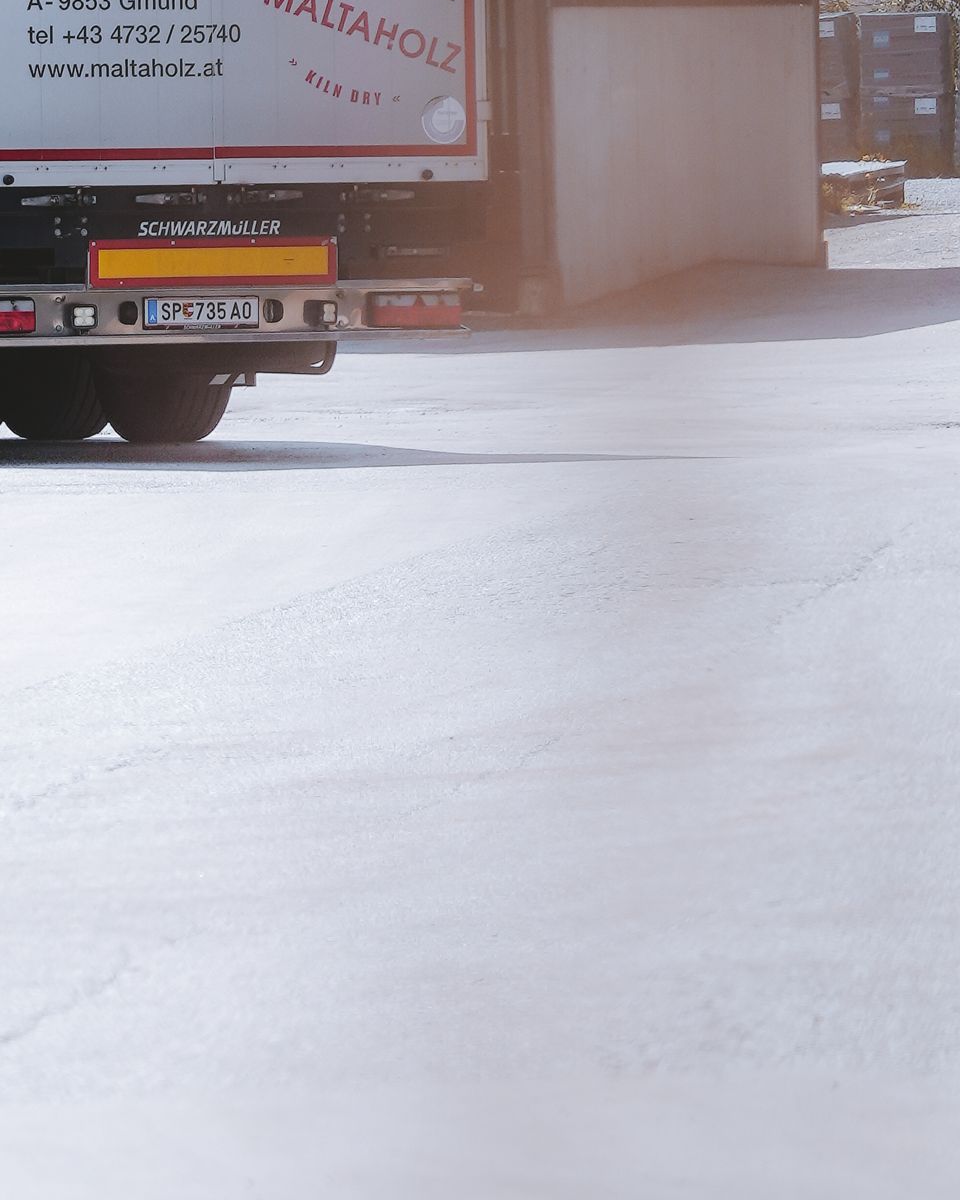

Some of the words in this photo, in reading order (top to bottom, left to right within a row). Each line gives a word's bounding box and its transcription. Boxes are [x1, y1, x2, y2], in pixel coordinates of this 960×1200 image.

[27, 25, 54, 45] tel
[62, 25, 103, 45] +43
[110, 25, 161, 45] 4732
[180, 24, 242, 44] 25740
[28, 58, 224, 78] www.maltaholz.at
[304, 69, 343, 98] KILN
[350, 88, 382, 106] DRY
[161, 303, 182, 320] SP
[195, 302, 227, 320] 735
